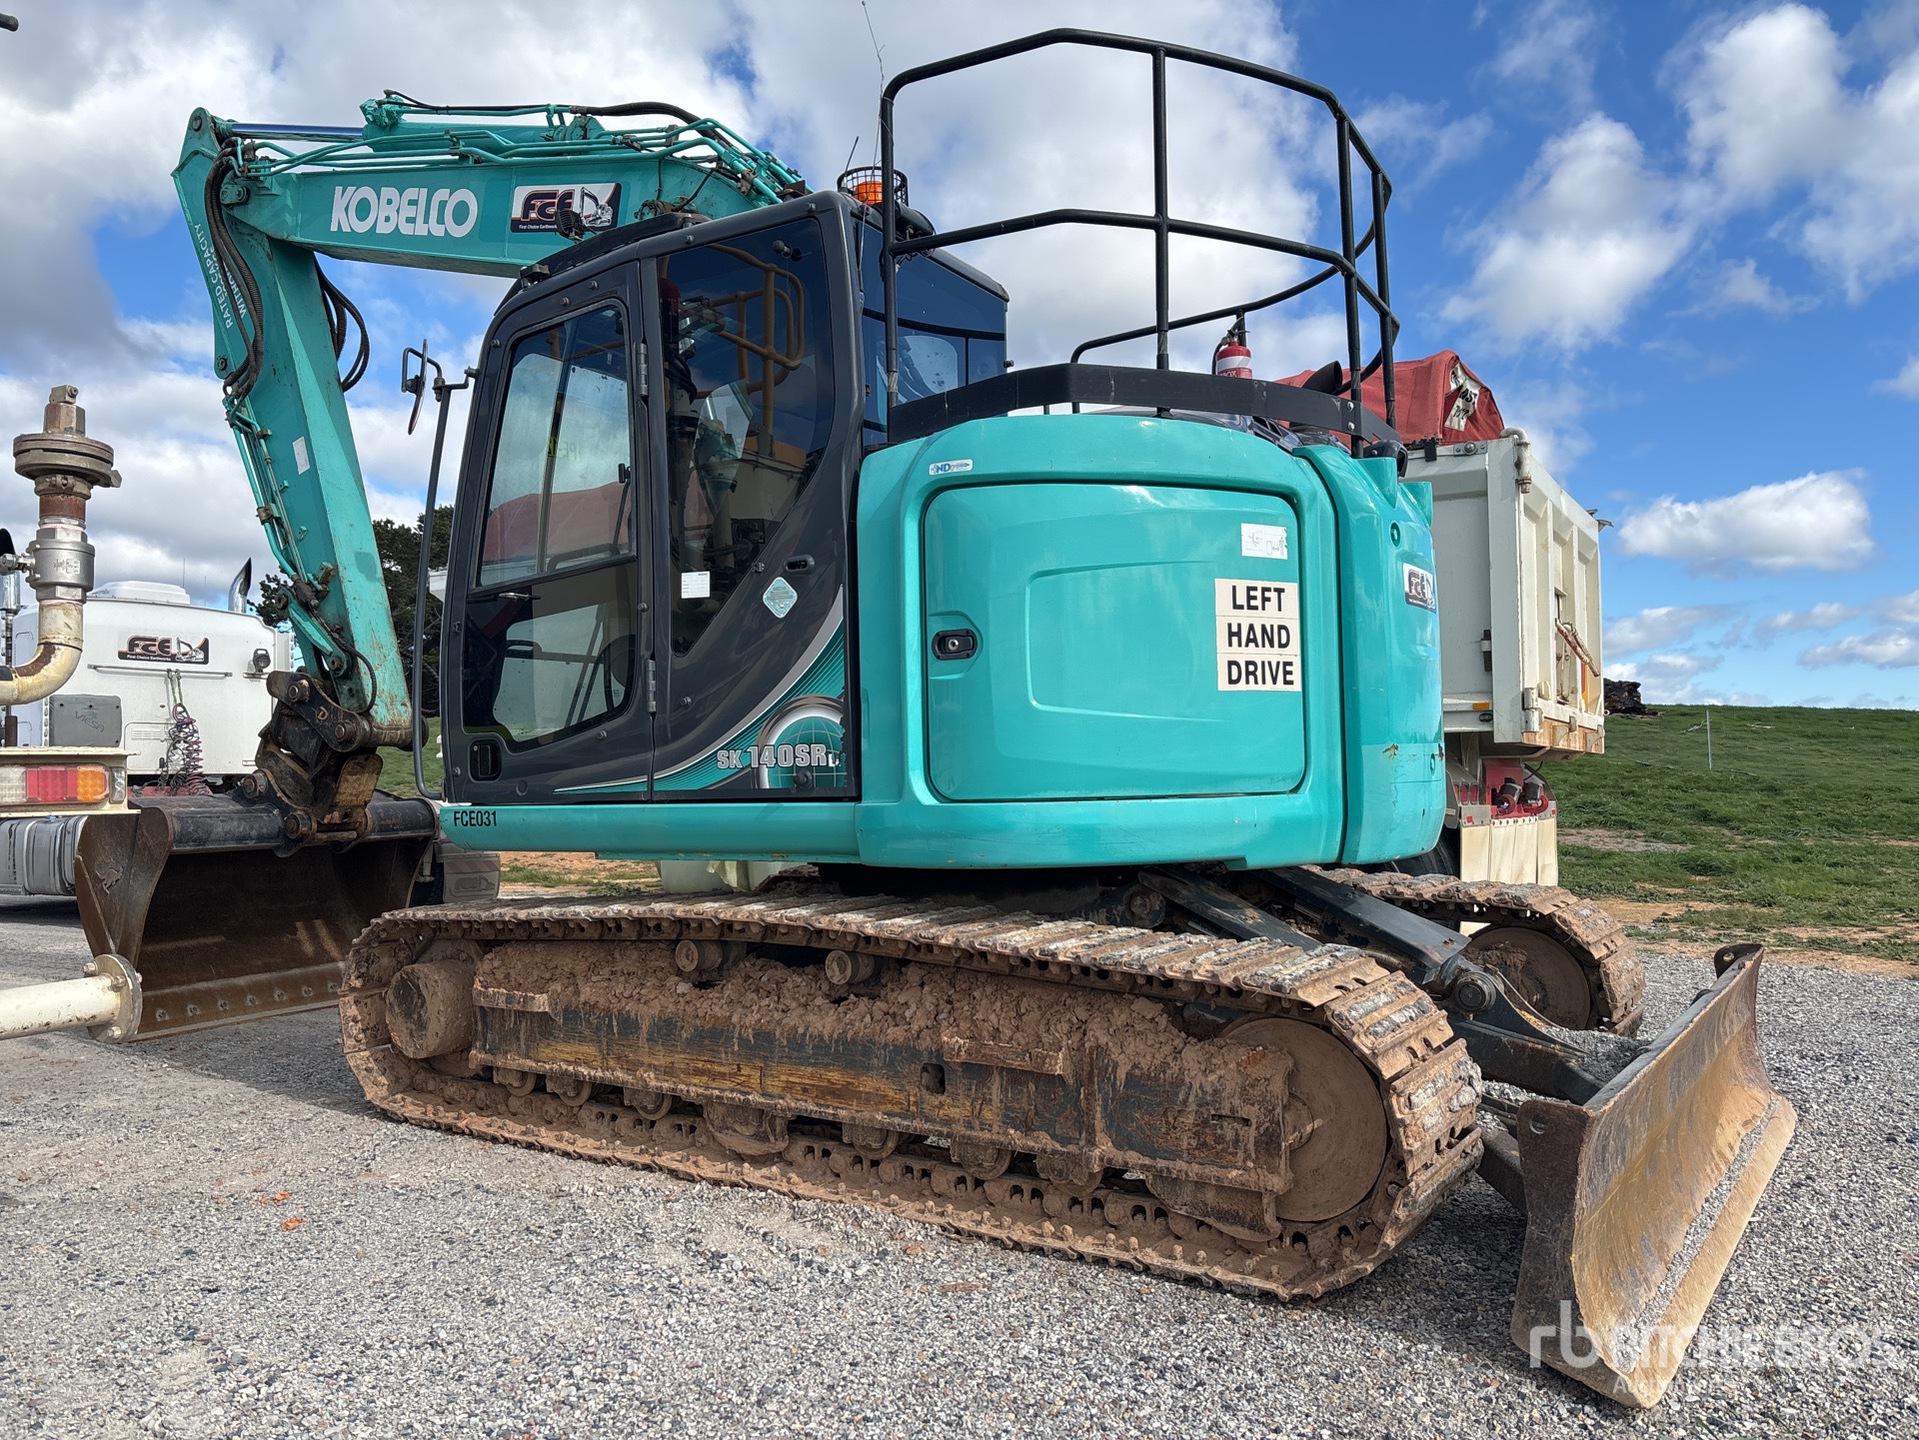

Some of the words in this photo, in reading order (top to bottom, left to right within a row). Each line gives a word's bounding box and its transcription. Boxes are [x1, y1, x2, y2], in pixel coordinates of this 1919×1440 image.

[330, 186, 478, 237] KOBELCO
[195, 223, 219, 284] CAPACITY
[215, 286, 233, 329] RATED
[1232, 585, 1285, 612] LEFT
[127, 635, 172, 656] FCE
[1227, 622, 1290, 649] HAND
[1227, 660, 1294, 685] DRIVE
[716, 749, 743, 770] SK
[453, 810, 498, 827] FCE031
